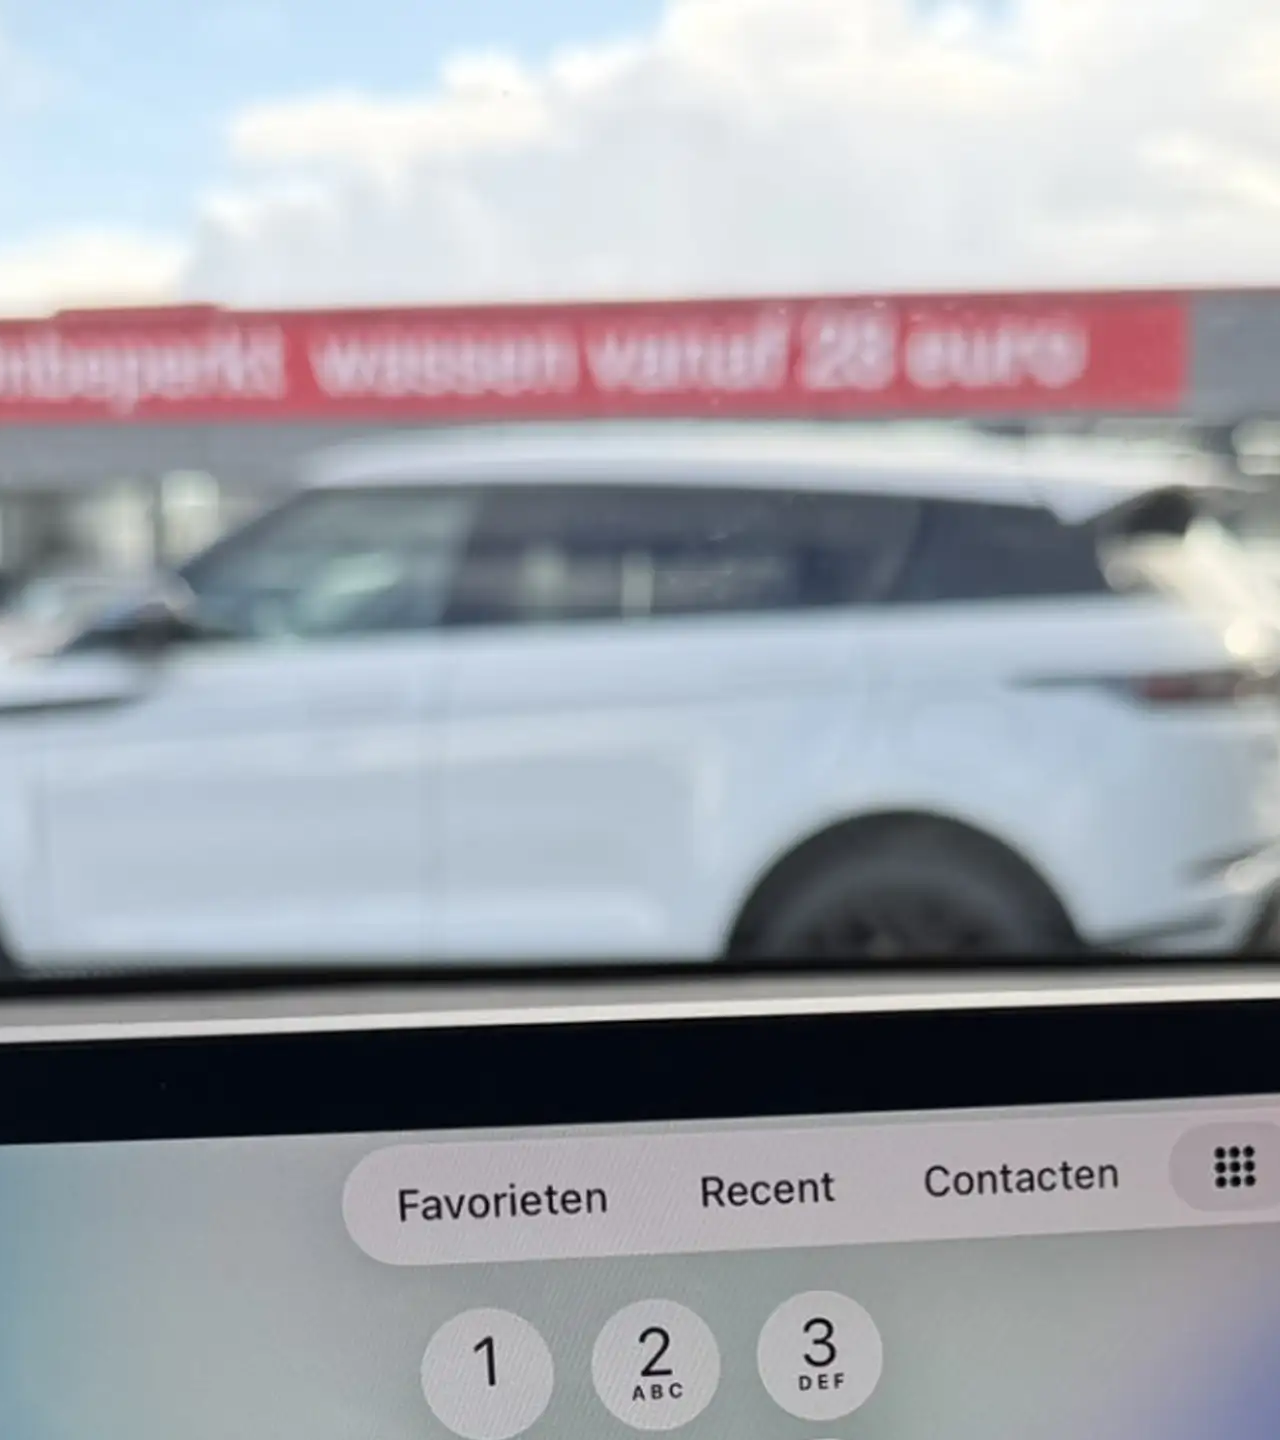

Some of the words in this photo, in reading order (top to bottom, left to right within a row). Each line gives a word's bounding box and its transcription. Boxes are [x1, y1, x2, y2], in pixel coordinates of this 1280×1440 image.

[908, 312, 1086, 388] euro
[701, 1172, 835, 1208] Recent
[924, 1161, 1118, 1197] Contacten
[398, 1183, 607, 1222] Favorieten
[473, 1335, 496, 1387] 1
[638, 1326, 673, 1377] 2
[803, 1317, 837, 1368] 3
[632, 1382, 683, 1401] ABC
[798, 1372, 844, 1391] DEF
